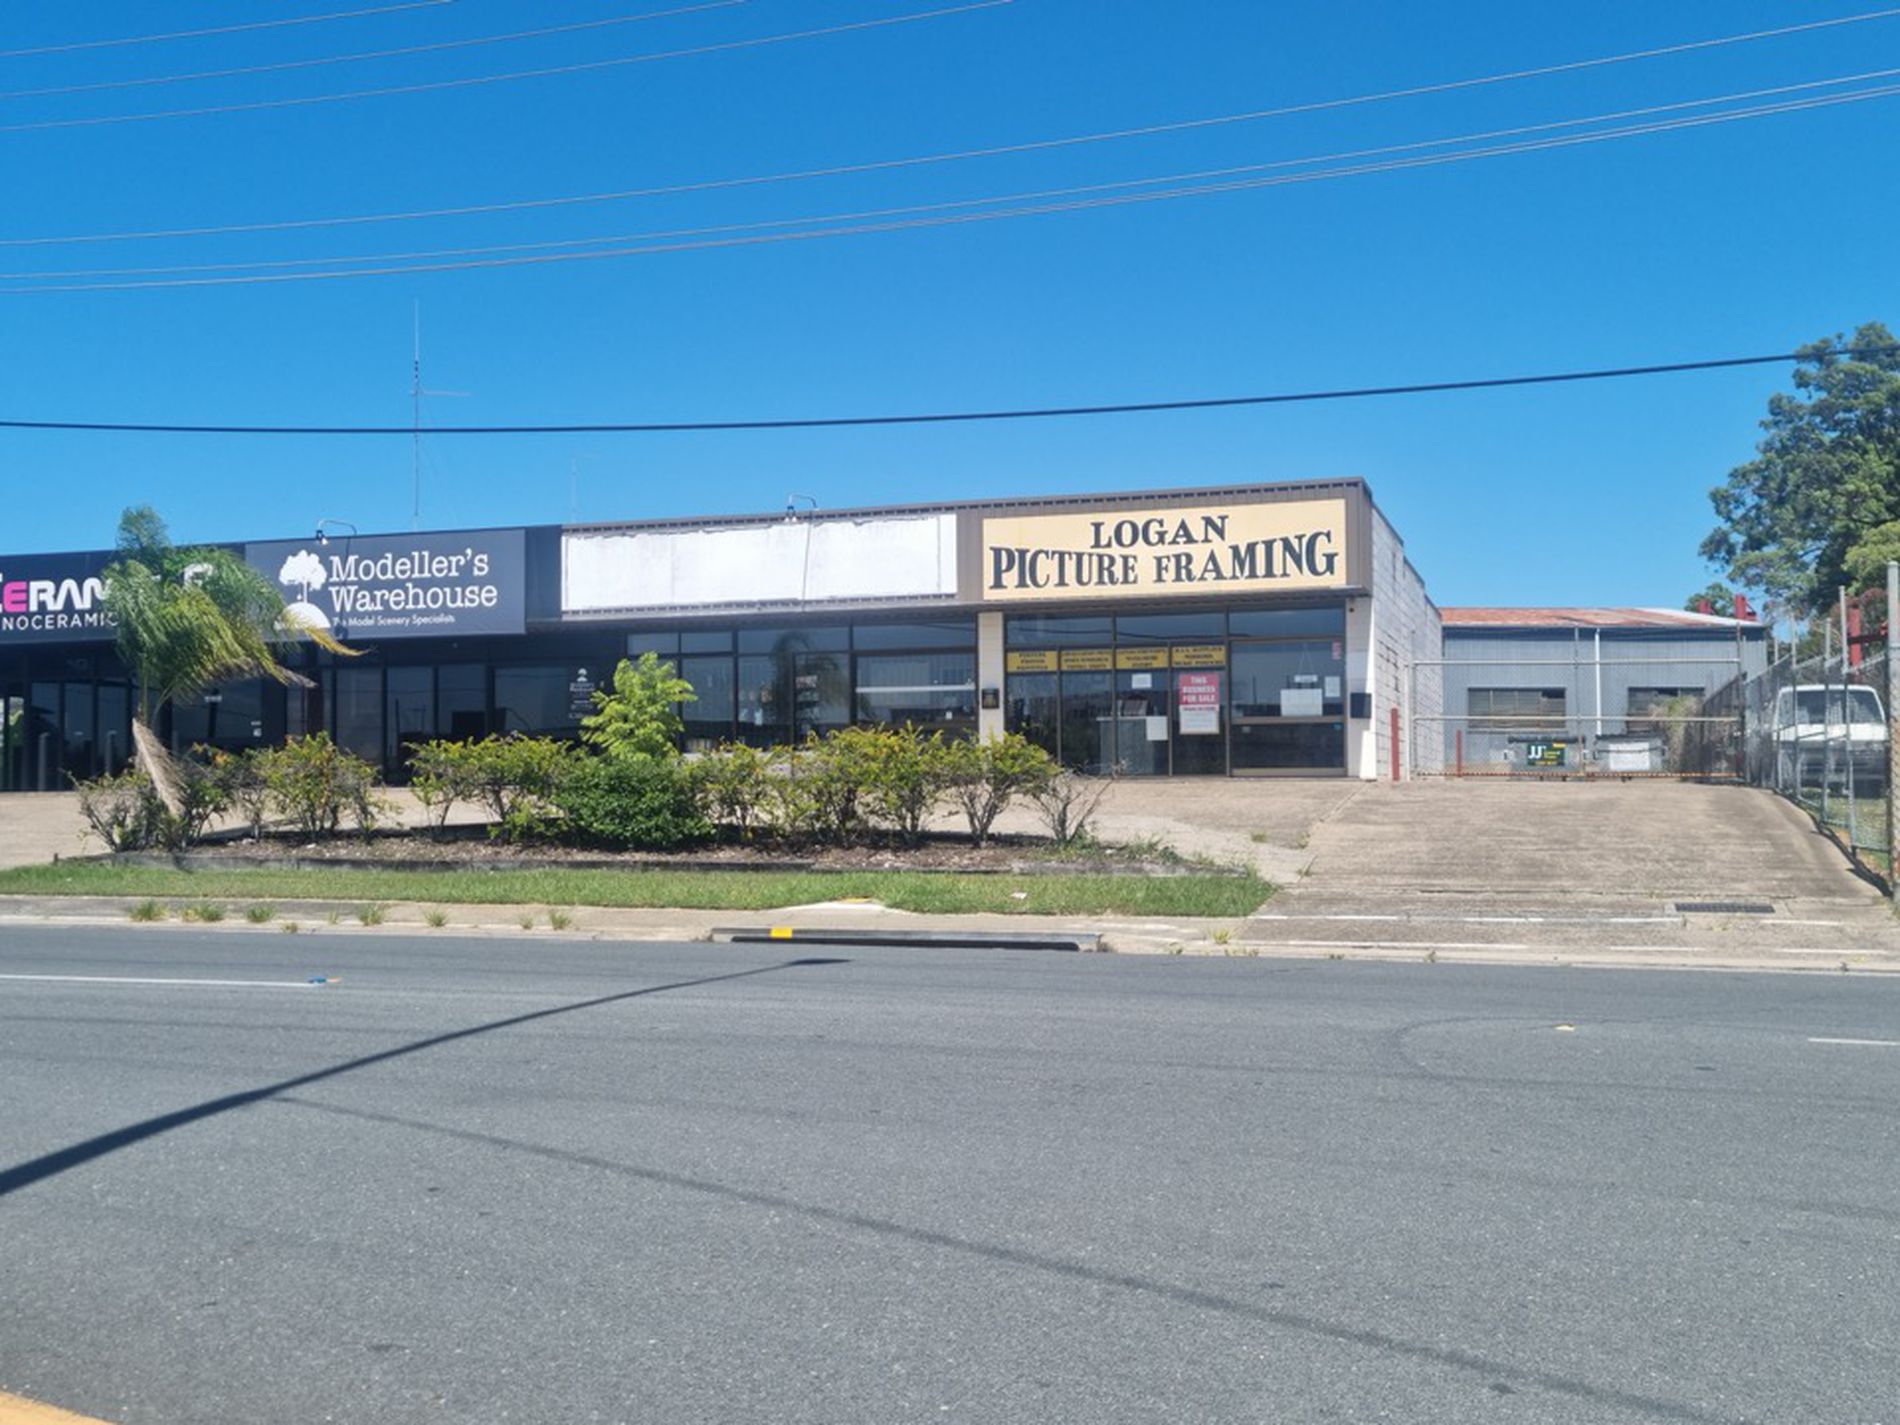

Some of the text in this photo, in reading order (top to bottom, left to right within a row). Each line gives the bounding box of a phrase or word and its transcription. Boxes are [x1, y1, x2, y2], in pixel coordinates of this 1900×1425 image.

[1090, 515, 1229, 549] LOGAN
[329, 548, 489, 583] Modeller's
[989, 530, 1338, 590] PICTURE FRAMING
[329, 582, 498, 613] Warehouse
